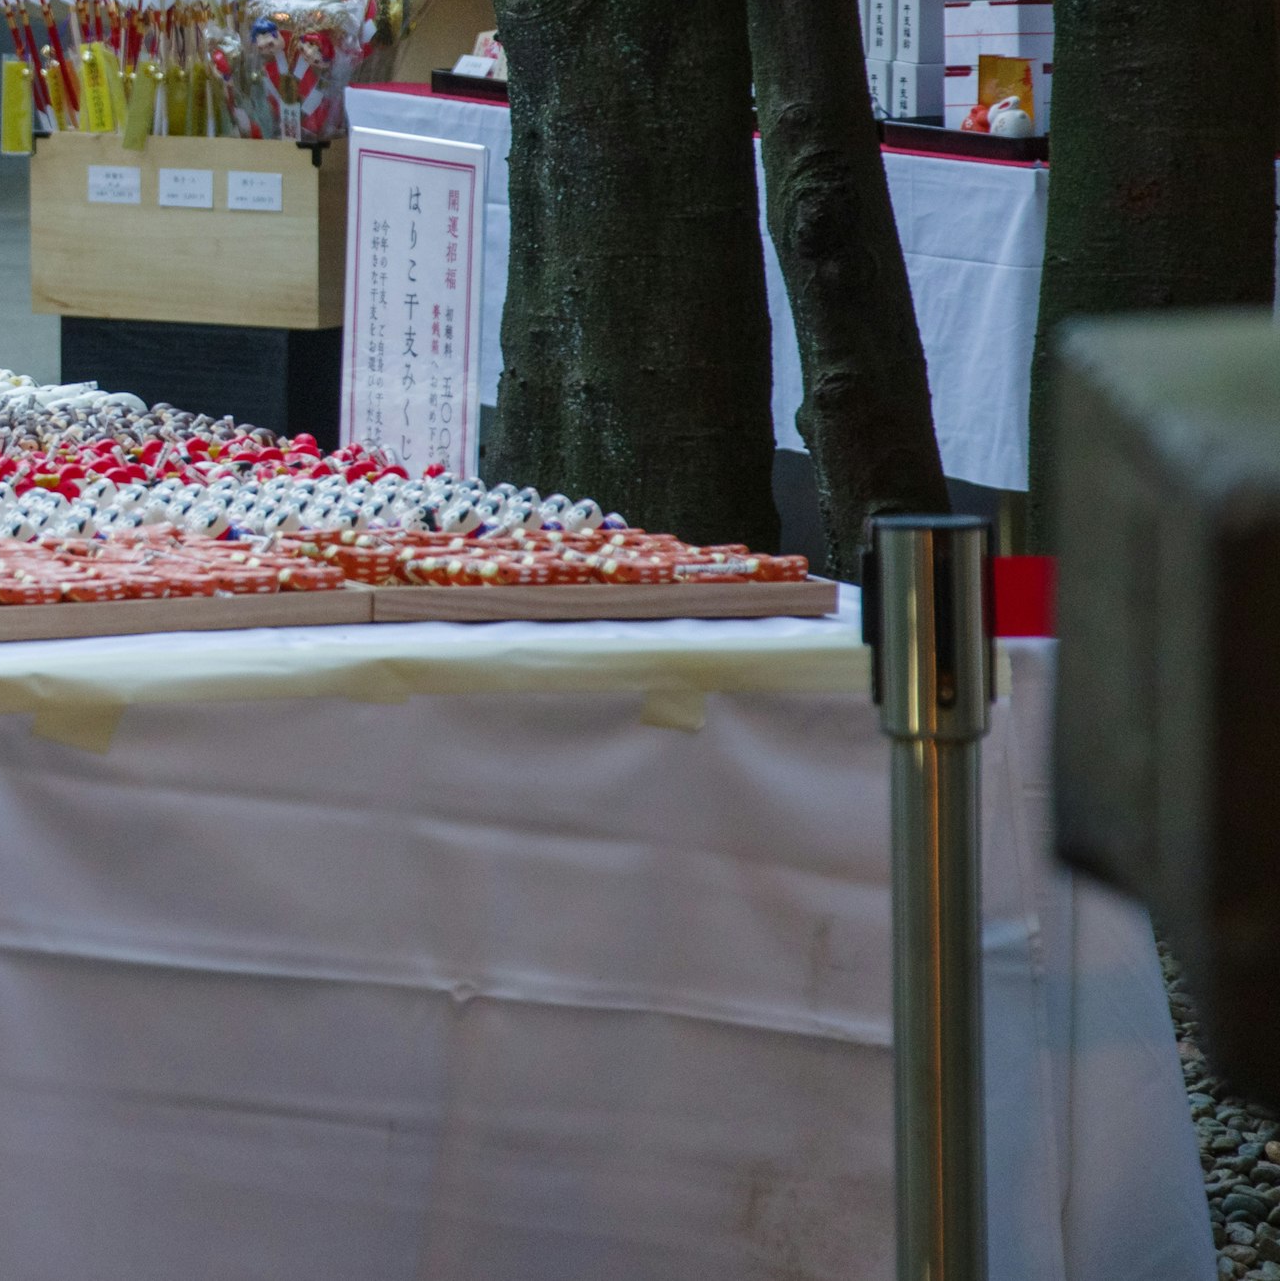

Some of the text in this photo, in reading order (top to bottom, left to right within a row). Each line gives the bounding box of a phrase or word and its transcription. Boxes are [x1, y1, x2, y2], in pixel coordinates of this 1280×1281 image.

[401, 185, 422, 461] はりこ干支みくじ
[444, 189, 460, 290] 開運招福
